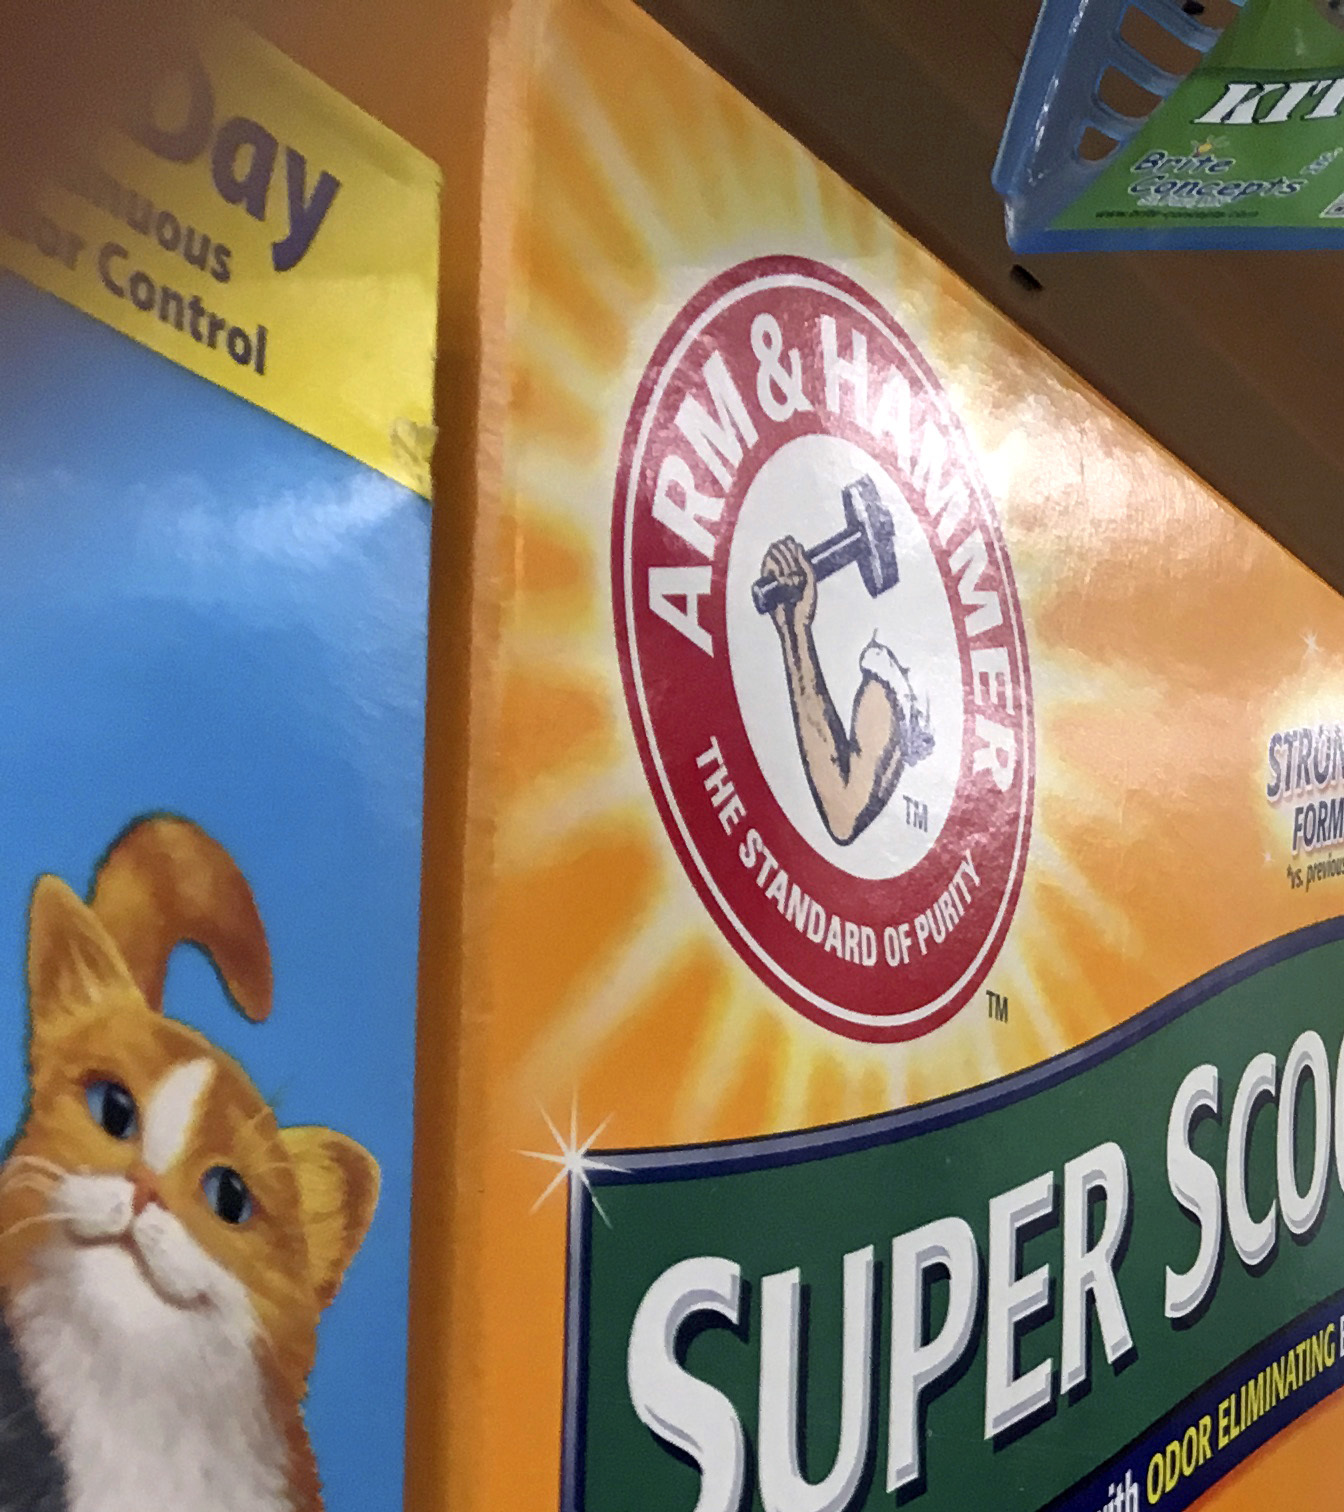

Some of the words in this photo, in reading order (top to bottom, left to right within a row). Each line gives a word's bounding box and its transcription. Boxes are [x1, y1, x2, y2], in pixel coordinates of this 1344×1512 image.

[1128, 173, 1308, 202] Concepts
[1131, 150, 1236, 174] Brite
[98, 241, 269, 377] Control
[648, 350, 759, 658] ARM
[750, 312, 815, 422] &
[819, 312, 1018, 792] HAMMER
[695, 736, 747, 836] THE
[738, 828, 878, 967] STANDARD
[883, 925, 914, 967] OF
[915, 848, 982, 956] PURITY
[902, 795, 929, 833] TM
[985, 989, 1010, 1023] TM
[1146, 1414, 1215, 1505] ODOR
[1217, 1322, 1336, 1451] ELIMINATING
